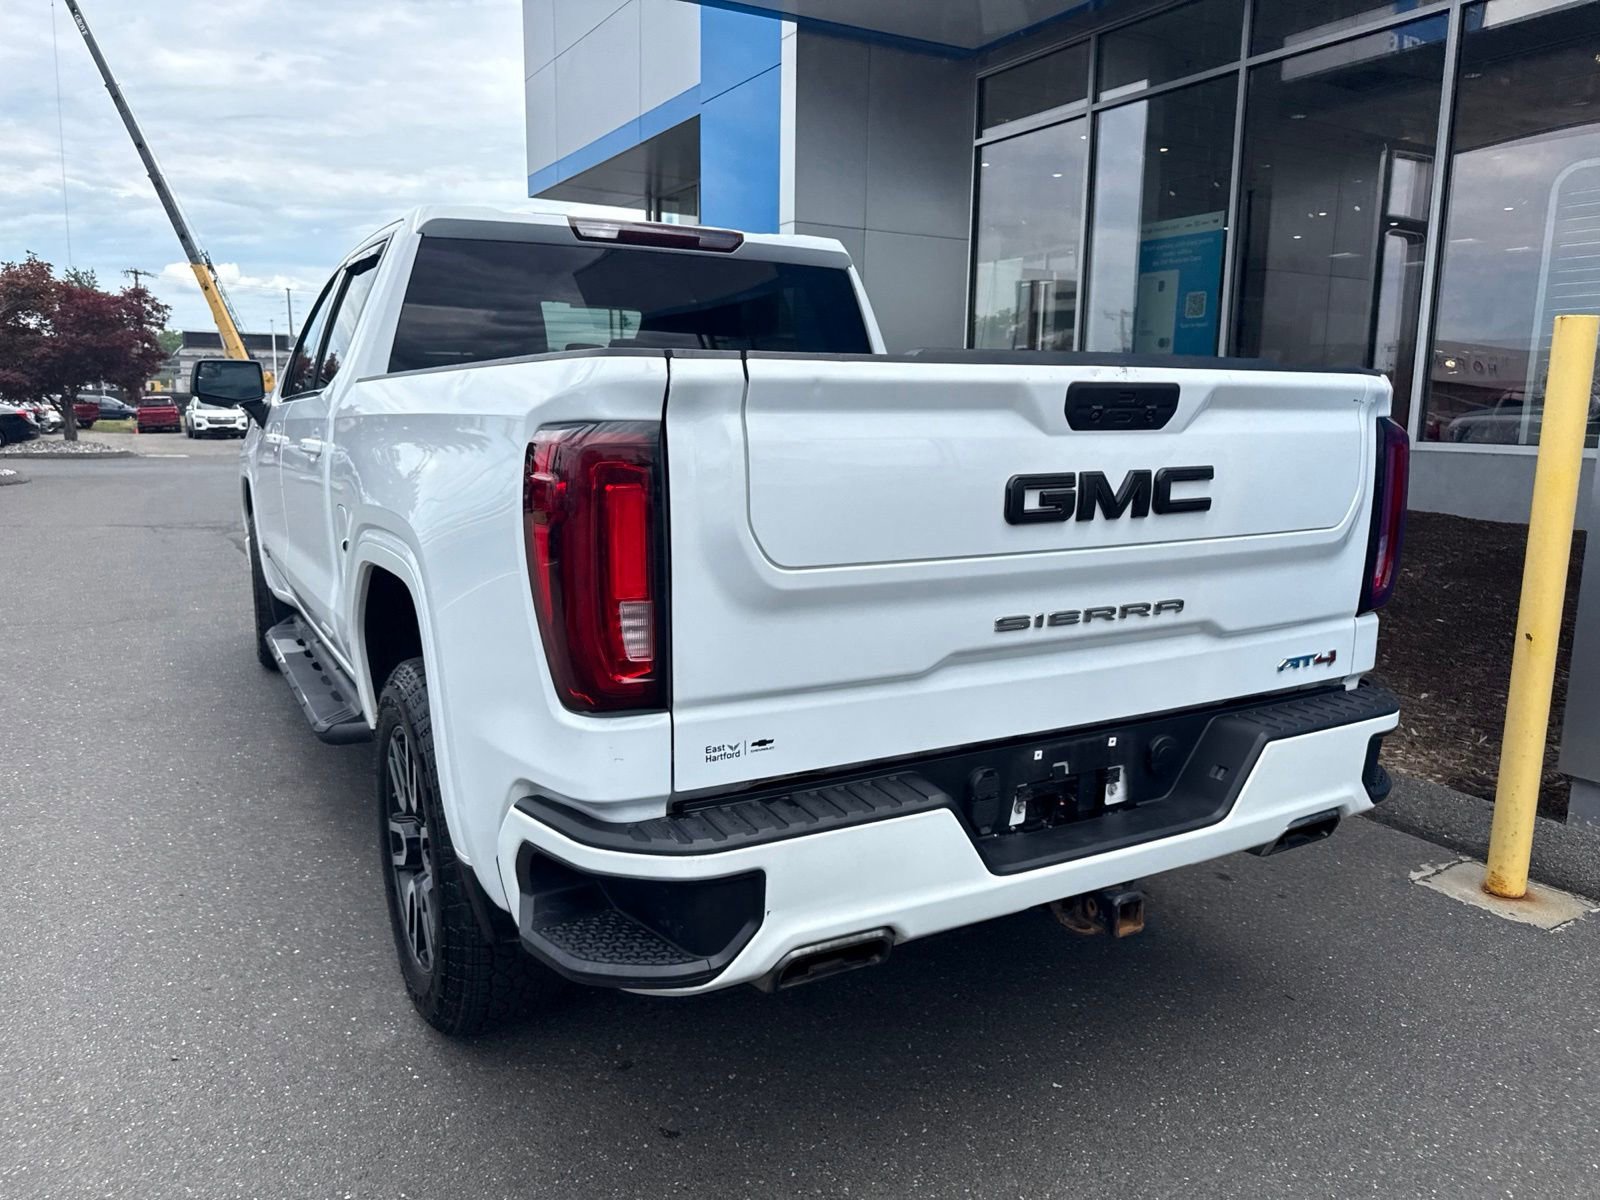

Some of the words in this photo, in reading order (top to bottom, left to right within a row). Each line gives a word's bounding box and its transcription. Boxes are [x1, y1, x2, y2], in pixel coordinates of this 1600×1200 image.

[1004, 465, 1214, 525] GMC
[993, 598, 1185, 632] SIERRA
[1277, 648, 1337, 672] AT4
[705, 744, 726, 754] East
[705, 750, 741, 763] Hartford
